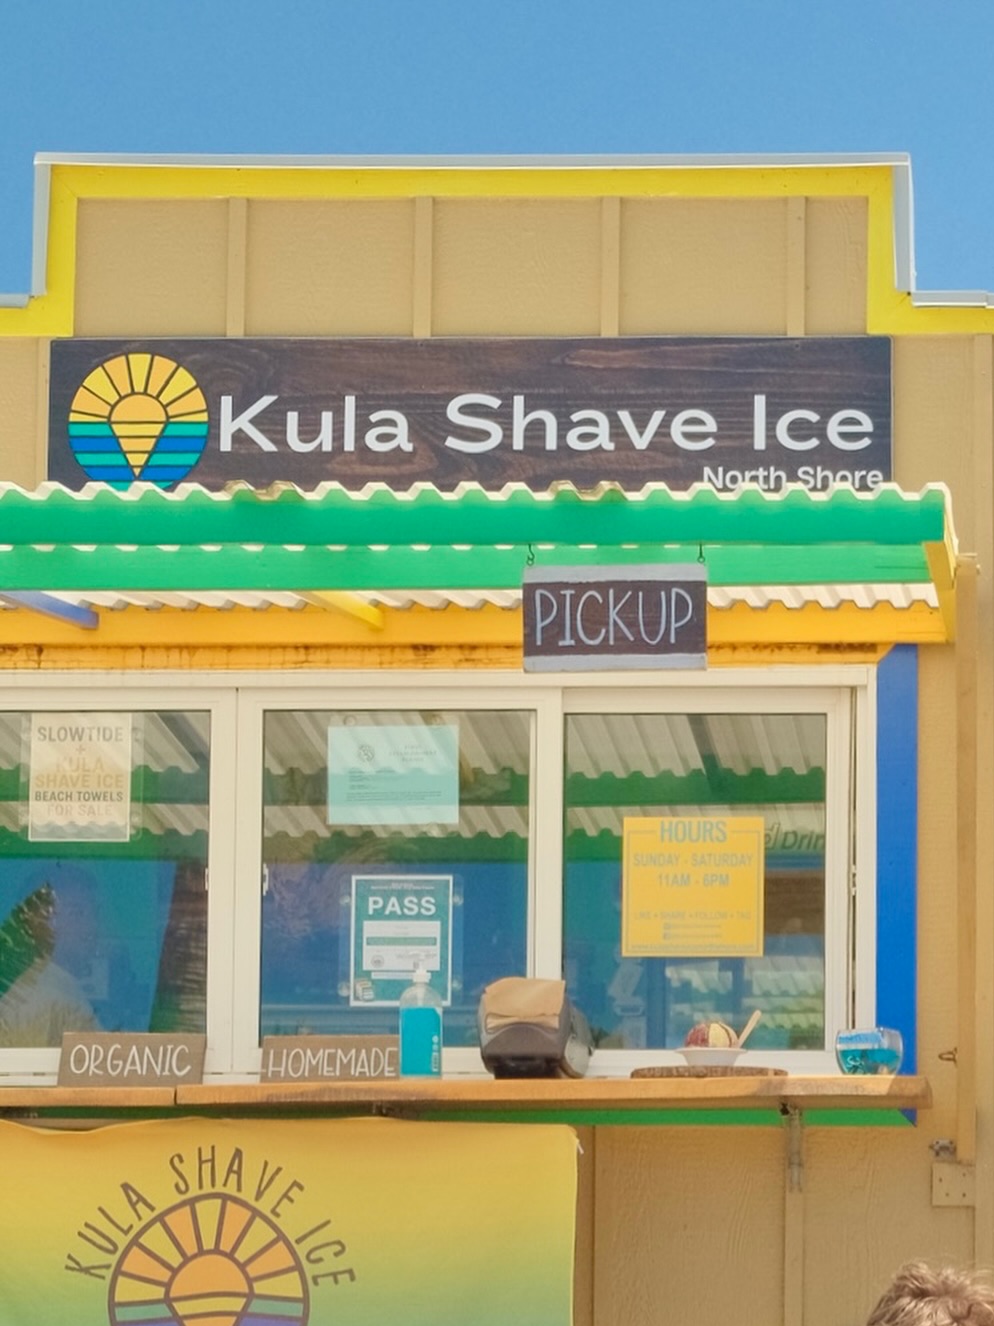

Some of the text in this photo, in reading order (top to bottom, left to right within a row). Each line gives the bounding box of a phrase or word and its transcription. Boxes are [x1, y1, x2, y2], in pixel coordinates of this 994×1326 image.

[219, 391, 875, 453] Kula Shave Ice
[702, 466, 884, 490] North Shore
[535, 587, 693, 647] PICKUP
[37, 726, 124, 743] SLOWTIDE
[56, 756, 104, 773] KULA
[35, 773, 124, 789] SHAVE ICE
[35, 791, 124, 802] BEACH TOWELS
[47, 803, 113, 817] FOR SALE
[660, 820, 728, 844] HOURS
[633, 852, 680, 867] SUNDAY
[690, 852, 754, 867] SATURDAY
[658, 873, 691, 887] 11AM
[702, 873, 730, 887] 6PM
[367, 896, 437, 916] PASS
[70, 1043, 192, 1078] ORGANIC
[267, 1046, 398, 1079] HOMEMADE
[64, 1144, 357, 1288] KULA SHAVE ICE
